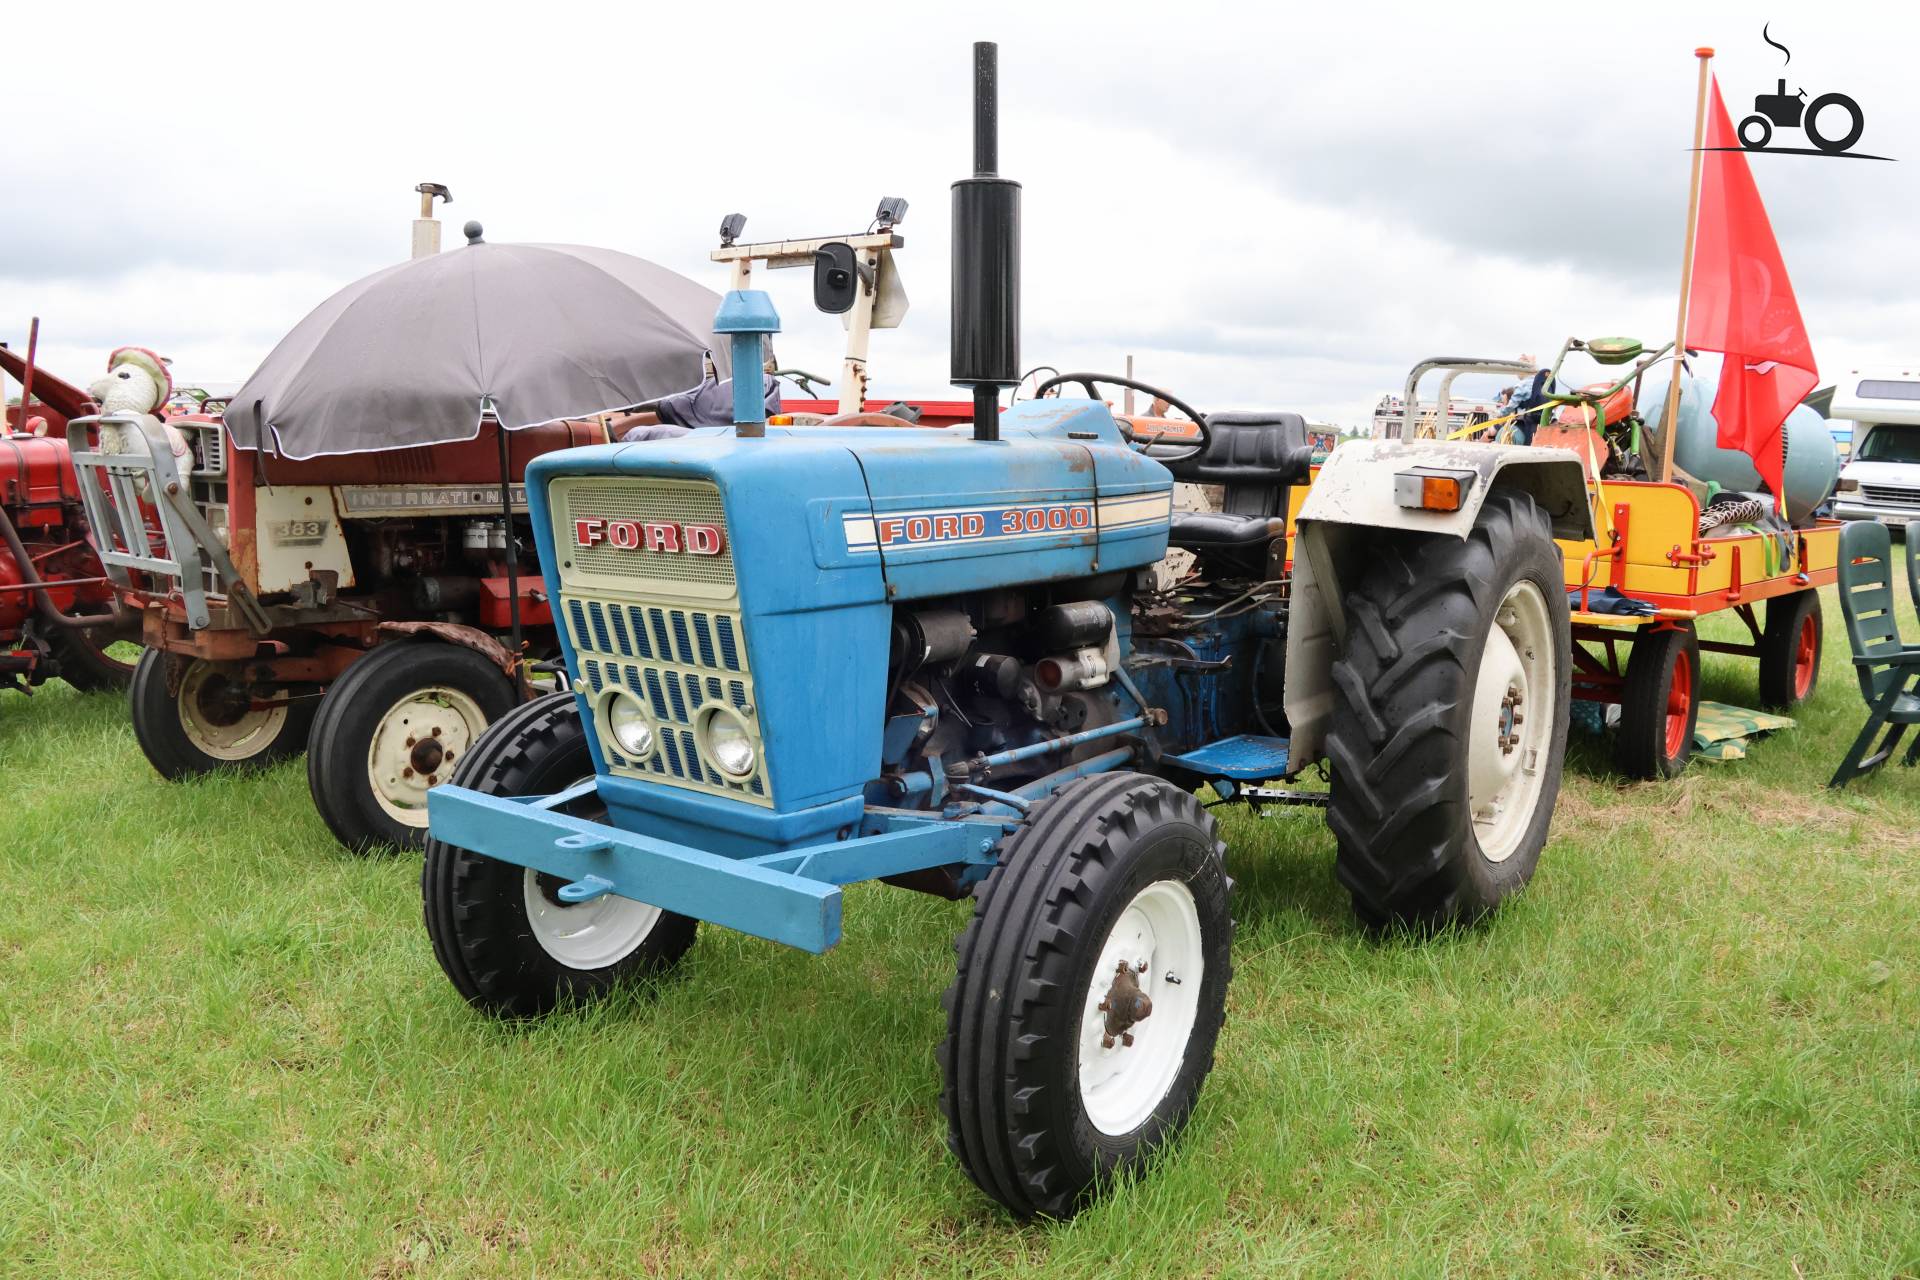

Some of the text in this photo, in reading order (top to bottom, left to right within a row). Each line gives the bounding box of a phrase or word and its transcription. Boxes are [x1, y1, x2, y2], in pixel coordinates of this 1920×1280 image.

[277, 522, 320, 537] 383
[575, 518, 724, 556] FORD
[879, 506, 1089, 544] FORD 3000
